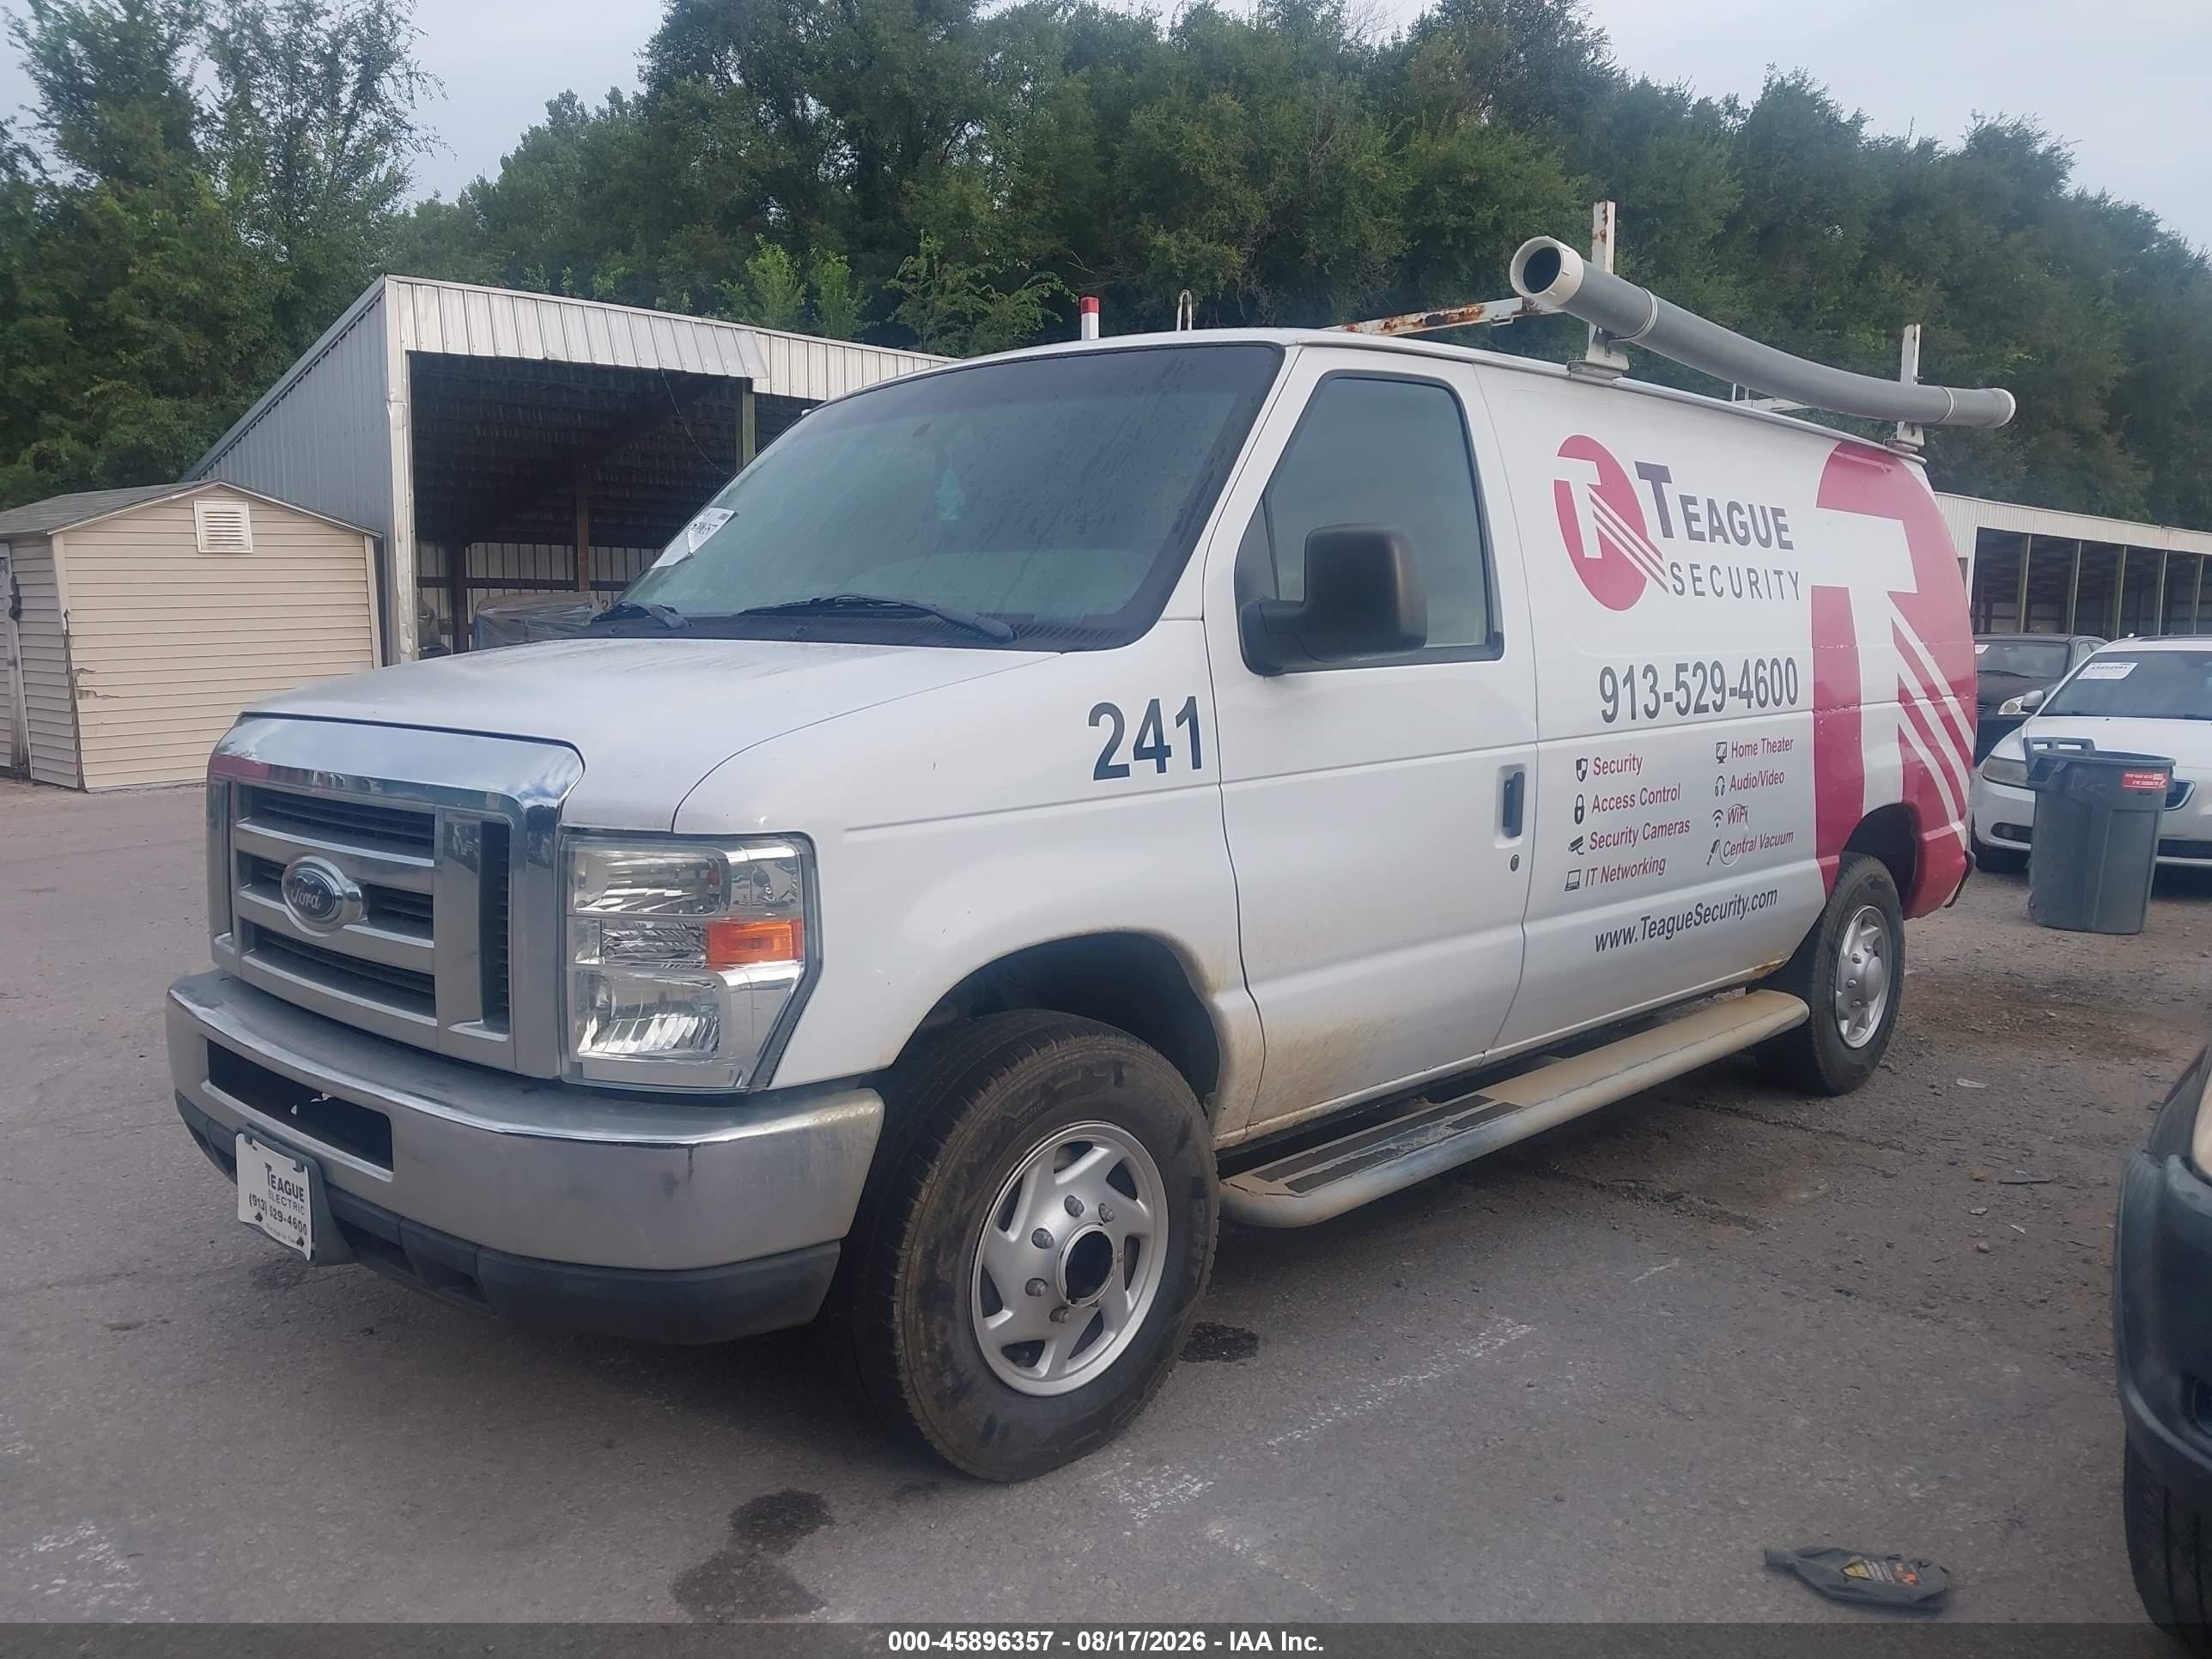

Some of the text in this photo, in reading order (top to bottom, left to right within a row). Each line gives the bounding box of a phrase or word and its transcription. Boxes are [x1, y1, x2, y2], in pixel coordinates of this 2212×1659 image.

[1634, 460, 1794, 551] TEAGUE
[1669, 560, 1801, 601] SECURITY
[1599, 656, 1799, 724] 913-529-4600
[1088, 696, 1202, 781] 241
[1730, 737, 1794, 759] Home Theater
[1593, 753, 1644, 776] Security
[1729, 770, 1785, 793] Audio/Video
[1591, 783, 1681, 814] Access Control
[1589, 818, 1691, 851] Security Cameras
[1723, 831, 1794, 857] Central Vacuum
[1584, 856, 1667, 888] IT Networking
[291, 875, 323, 909] Ford
[1595, 887, 1778, 953] www.TeagueSecurity.com
[264, 1162, 305, 1203] TEAGUE
[249, 1192, 268, 1216] (913)
[270, 1205, 307, 1237] 529-4600
[268, 1188, 306, 1216] ELECTRIC
